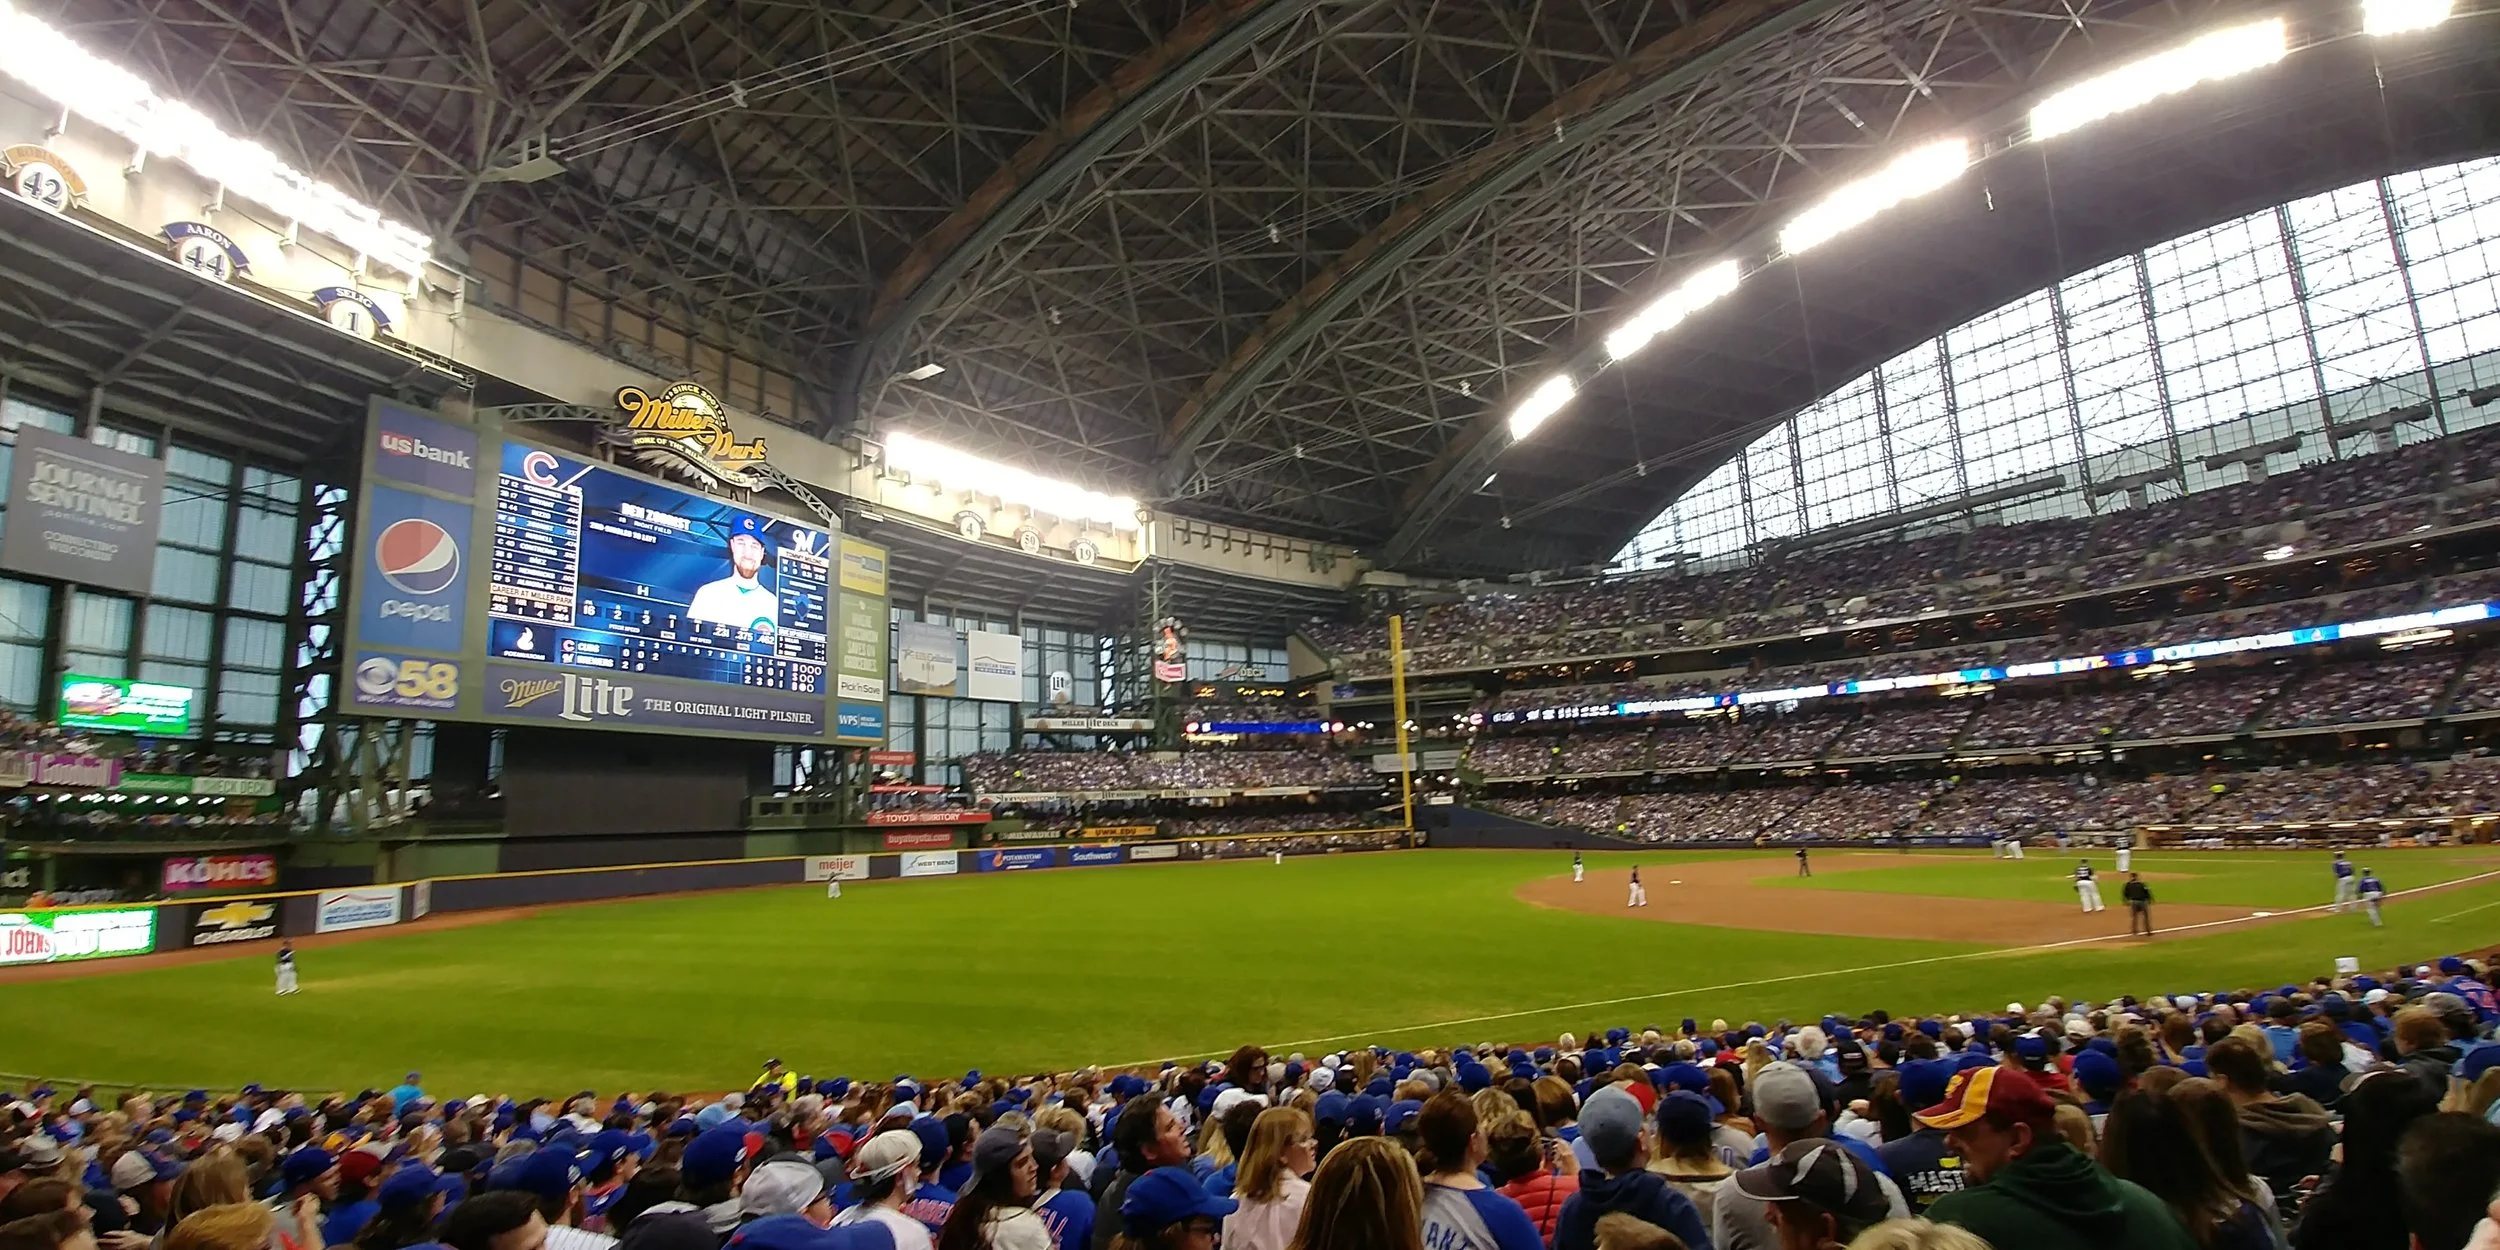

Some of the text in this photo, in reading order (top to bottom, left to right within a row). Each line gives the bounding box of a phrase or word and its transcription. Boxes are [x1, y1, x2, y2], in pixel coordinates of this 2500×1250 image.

[23, 171, 62, 206] 42
[186, 223, 232, 249] AARON
[185, 245, 225, 280] 44
[335, 287, 374, 309] SELIG
[672, 384, 699, 395] SINCE
[619, 388, 717, 430] Miller
[701, 391, 719, 409] 2001
[698, 424, 768, 461] Park
[634, 437, 656, 446] HOME
[656, 438, 668, 446] OF
[669, 439, 685, 454] THE
[685, 449, 725, 476] MILWAUKEE
[29, 460, 146, 506] JOURNAL
[26, 482, 144, 525] SENTINEL
[43, 530, 119, 553] CONNECTING
[48, 540, 113, 562] WISCONSIN
[492, 584, 573, 604] CAREER AT MILLER PARK
[379, 599, 452, 623] pepsi
[583, 605, 596, 616] 16
[614, 610, 622, 620] 2
[642, 614, 651, 625] 3
[577, 642, 600, 653] CUBS
[577, 656, 614, 668] BREWERS
[1240, 667, 1265, 677] DECK
[395, 660, 459, 700] 58
[841, 681, 881, 695] Pick Save
[500, 672, 634, 722] Miller Lite
[643, 699, 672, 713] THE
[674, 701, 732, 718] ORIGINAL
[734, 706, 767, 720] LIGHT
[838, 714, 858, 727] WPS
[1086, 718, 1102, 728] Lite
[240, 779, 265, 794] DECK
[886, 812, 960, 823] TOYOTA TERRITORY
[888, 833, 951, 845] buyatoyota.com
[1095, 828, 1137, 837] UWM.EDU
[819, 857, 855, 871] meijer
[1002, 853, 1042, 862] POTAWATOMI
[1072, 851, 1113, 862] Southwest
